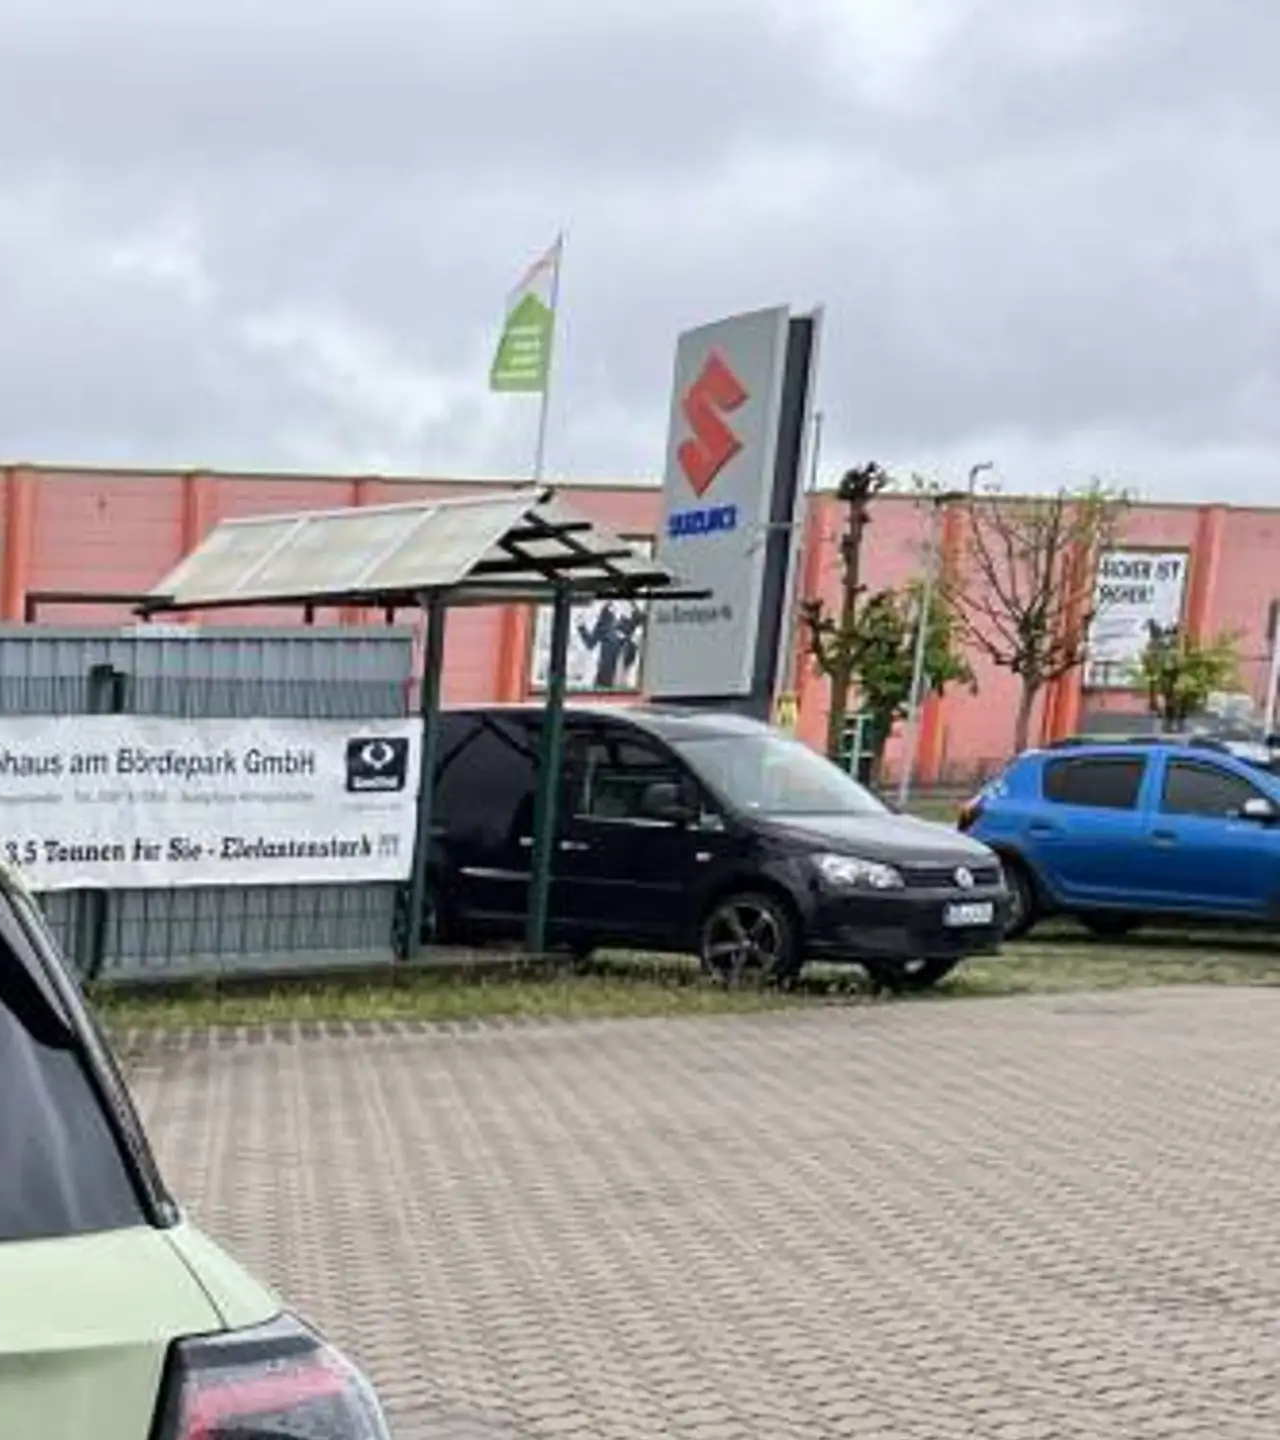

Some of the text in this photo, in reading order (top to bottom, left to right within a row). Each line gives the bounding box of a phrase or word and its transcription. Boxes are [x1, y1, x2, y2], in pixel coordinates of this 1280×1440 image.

[69, 756, 109, 775] am
[116, 747, 237, 779] Bördepark
[244, 749, 315, 776] GmbH
[44, 839, 126, 863] Tonnen
[167, 836, 203, 862] Sie
